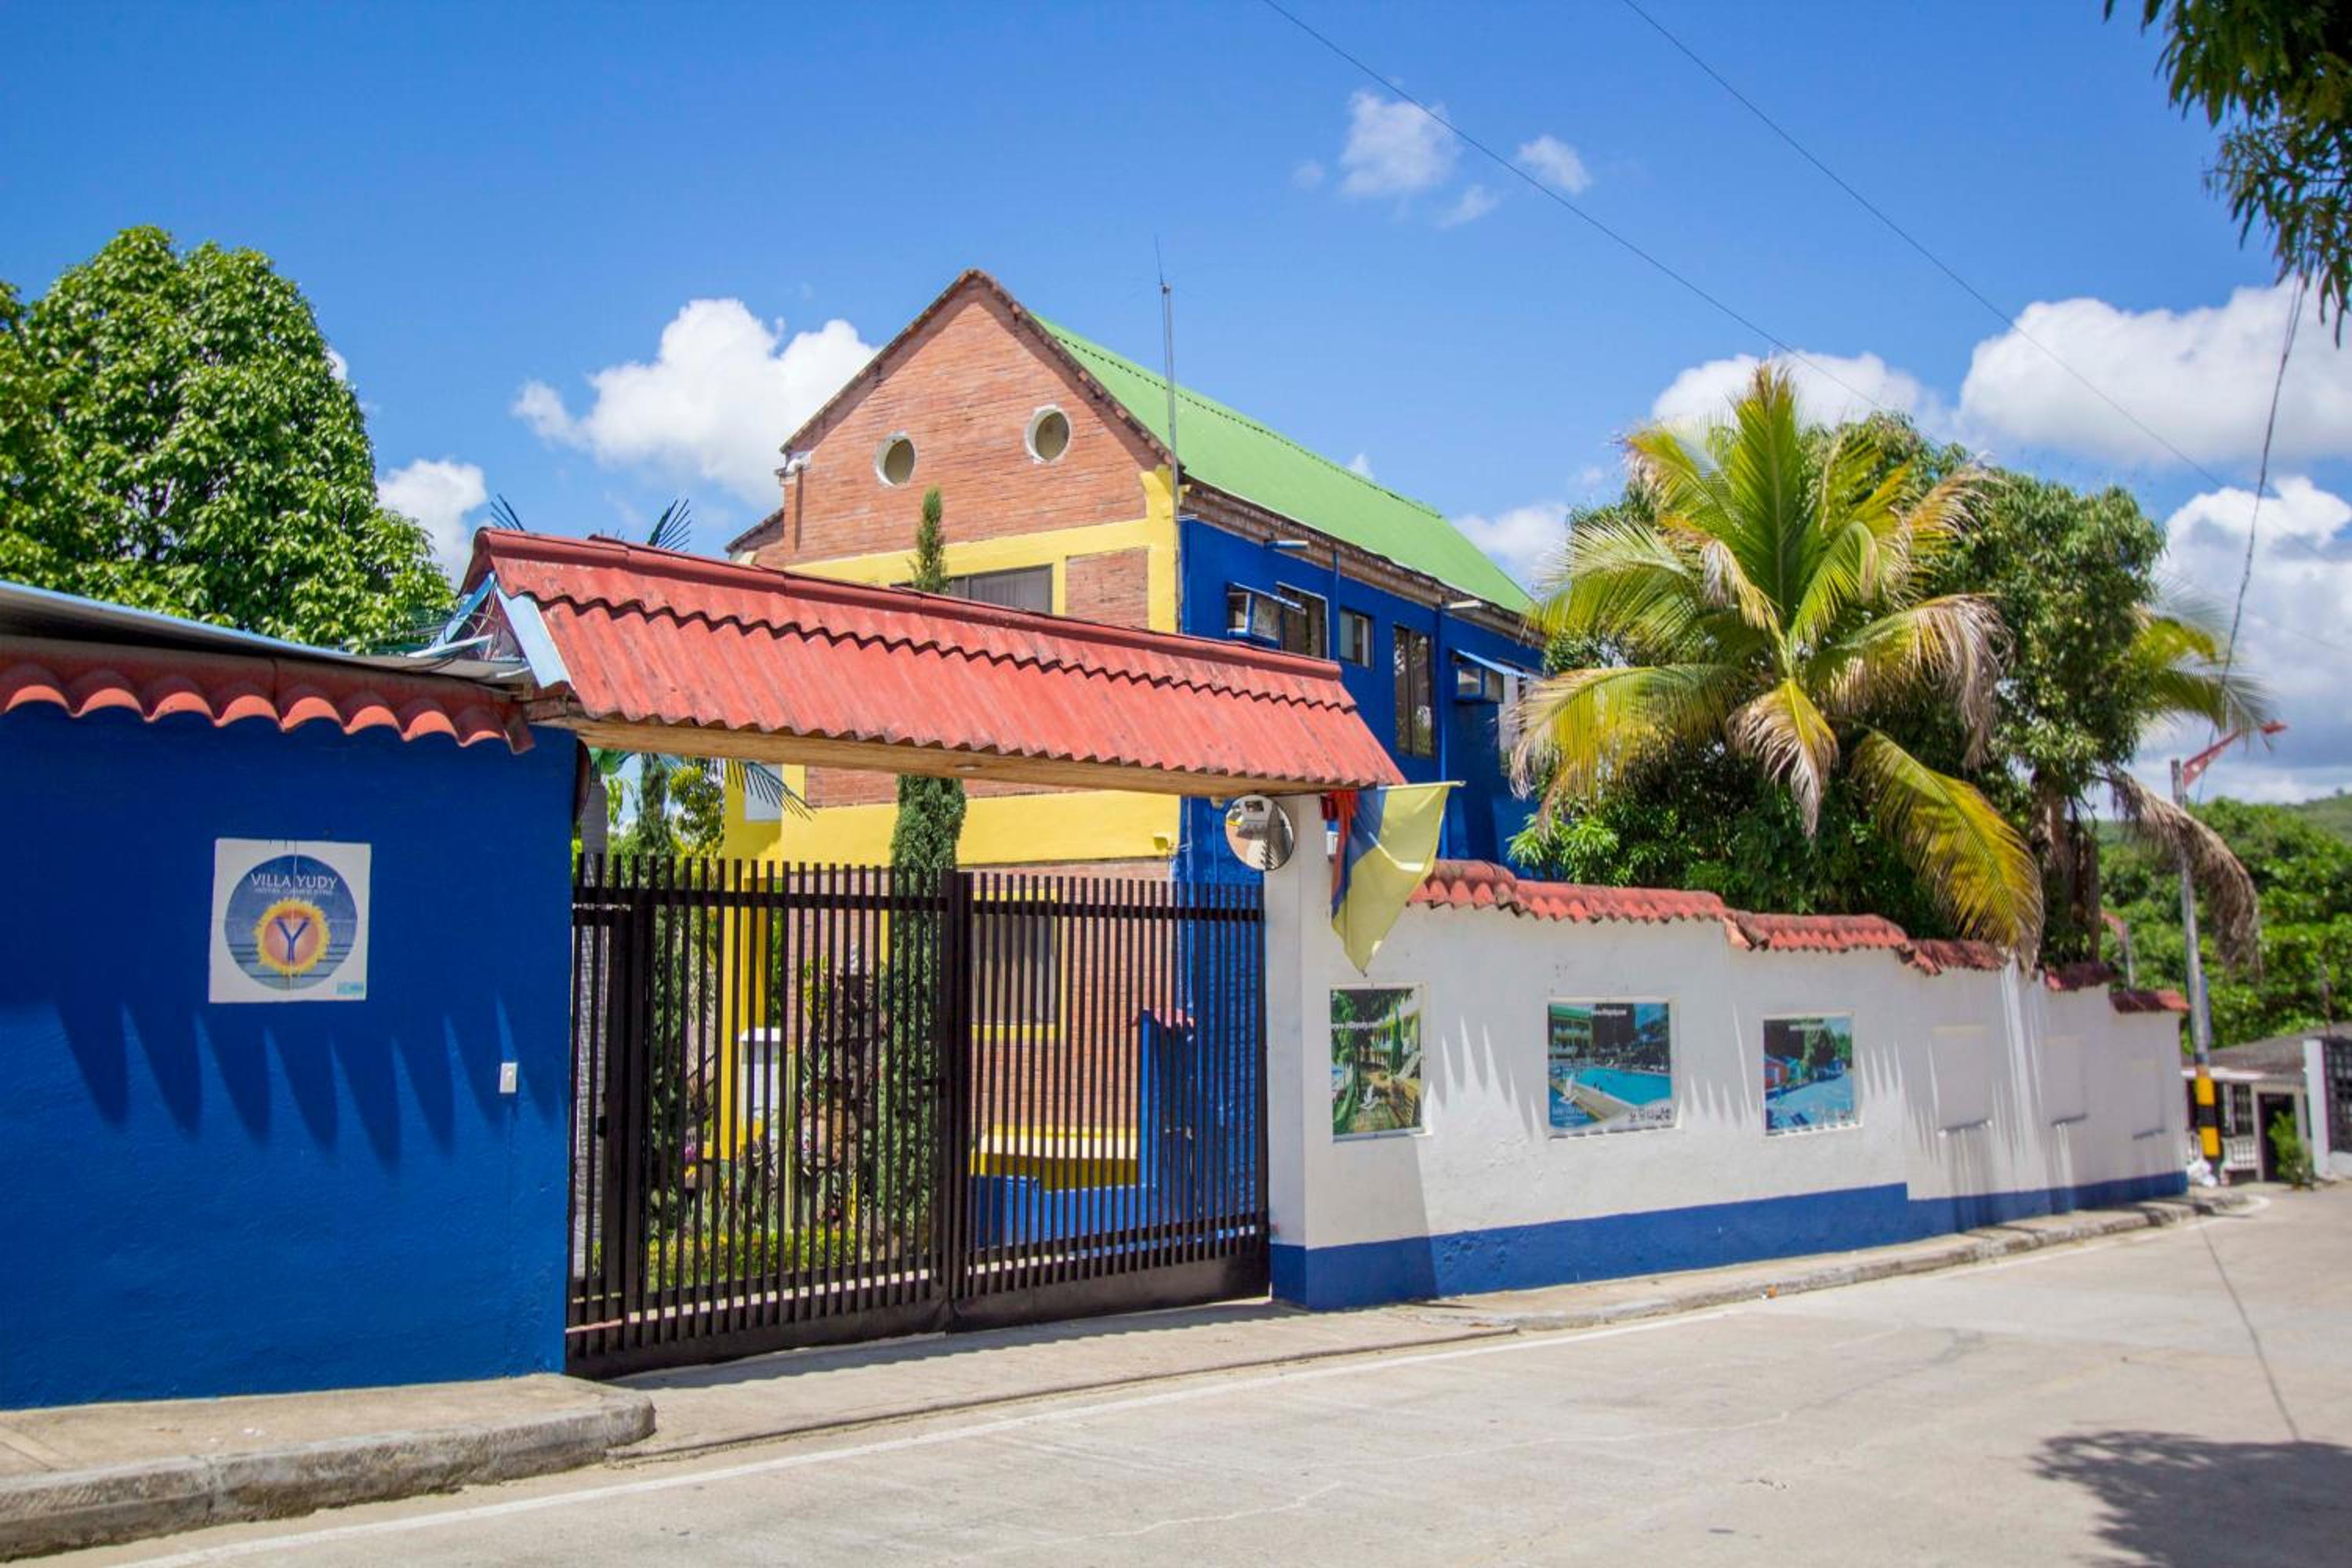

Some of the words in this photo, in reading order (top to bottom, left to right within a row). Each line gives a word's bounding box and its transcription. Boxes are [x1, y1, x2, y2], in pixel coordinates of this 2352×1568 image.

[250, 873, 292, 887] VILLA
[296, 874, 337, 889] YUDY
[275, 916, 310, 963] Y
